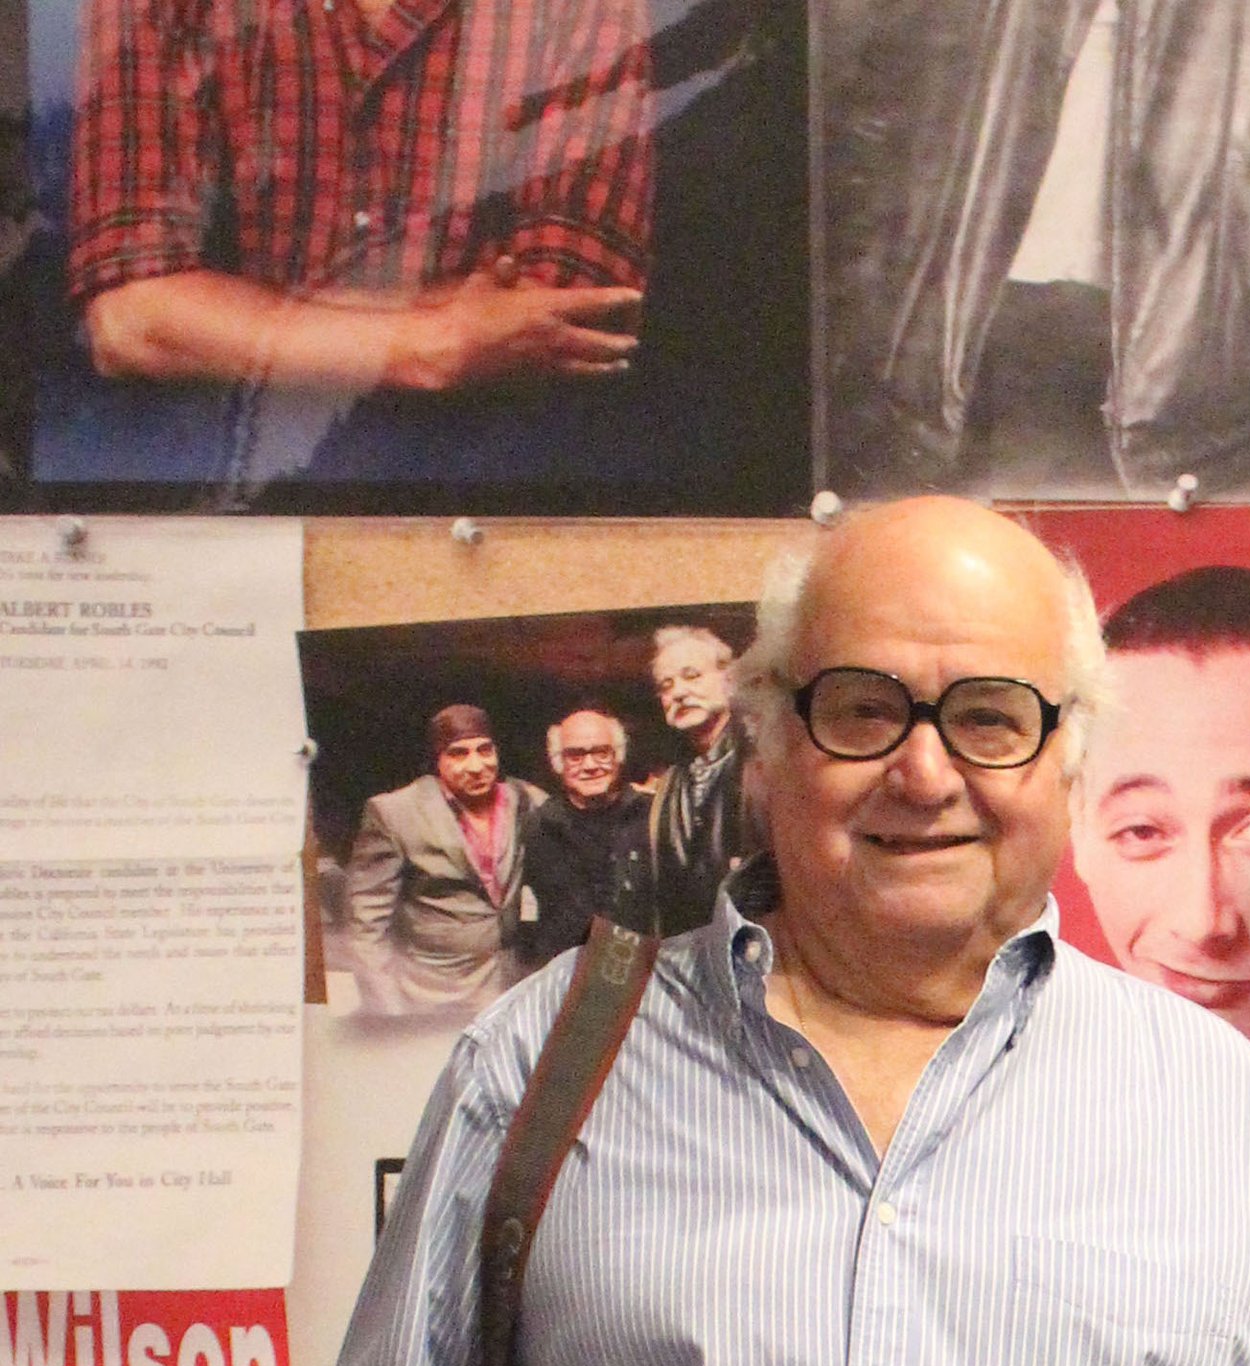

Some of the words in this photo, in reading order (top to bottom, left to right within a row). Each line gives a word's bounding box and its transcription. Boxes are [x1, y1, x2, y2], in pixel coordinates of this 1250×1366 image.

[79, 602, 152, 618] ROBLES
[75, 1172, 100, 1188] For
[106, 1171, 134, 1187] You
